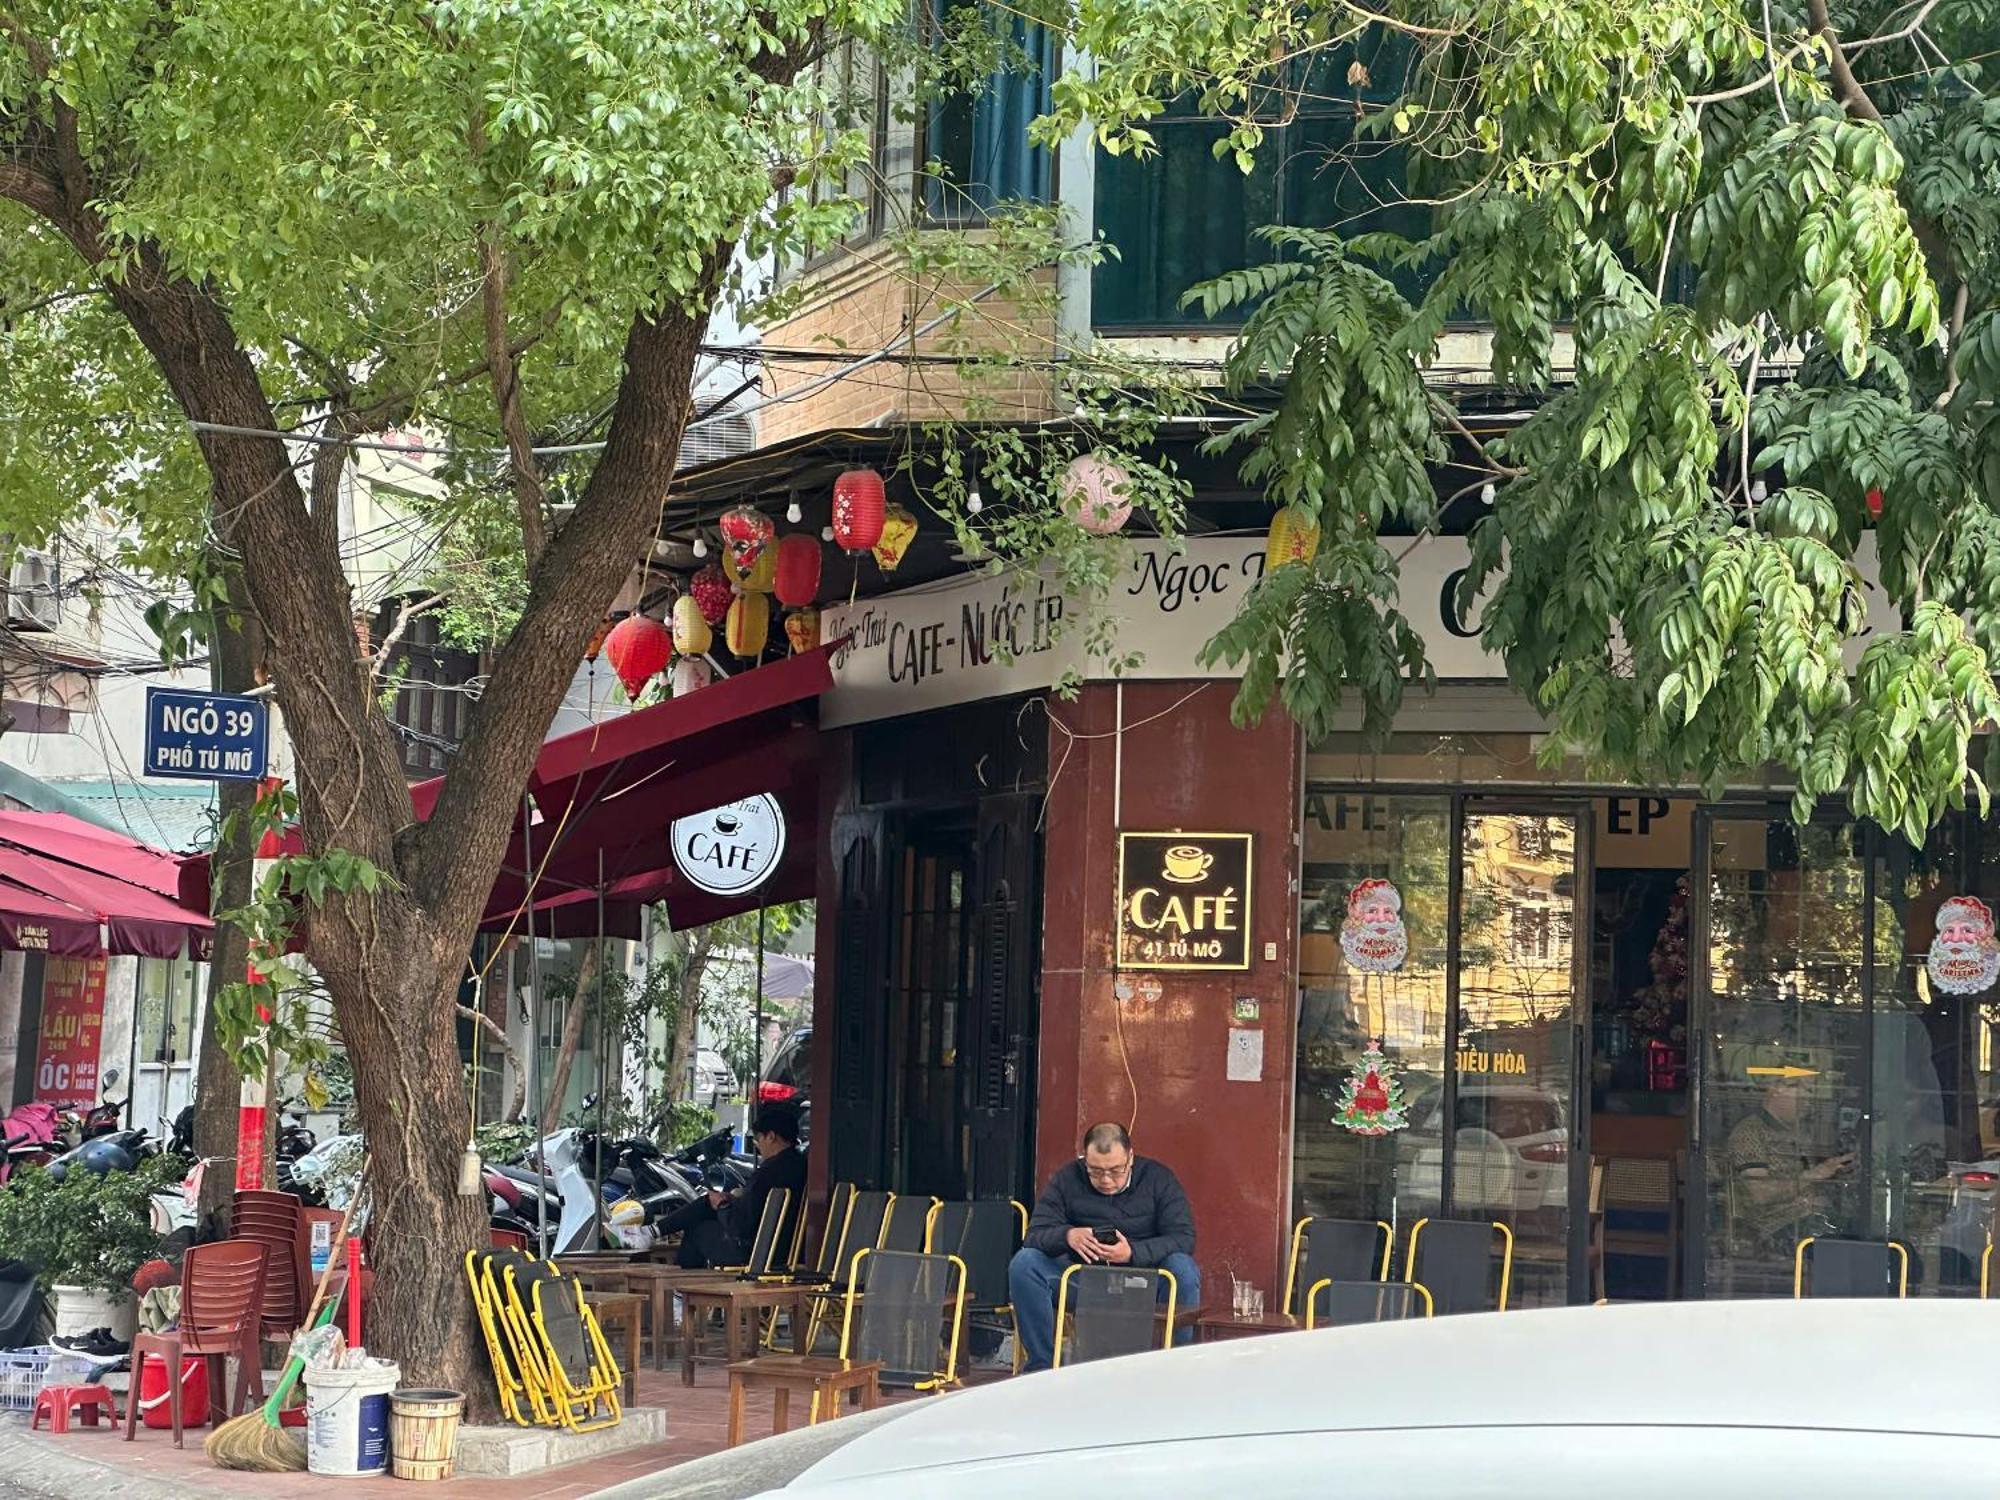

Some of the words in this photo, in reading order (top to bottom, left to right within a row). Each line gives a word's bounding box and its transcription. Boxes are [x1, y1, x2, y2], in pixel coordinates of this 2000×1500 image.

[1128, 551, 1230, 612] Ngọc
[888, 622, 945, 685] CAFE
[163, 701, 219, 736] NGÕ
[224, 710, 253, 737] 39
[157, 740, 193, 768] PHỐ
[198, 745, 220, 769] TÚ
[687, 832, 759, 873] CAFÉ
[1130, 887, 1238, 934] CAFÉ
[1144, 941, 1162, 960] 41
[1169, 938, 1188, 958] TÚ
[39, 1055, 70, 1090] ỐC
[1493, 1048, 1527, 1074] HÒA
